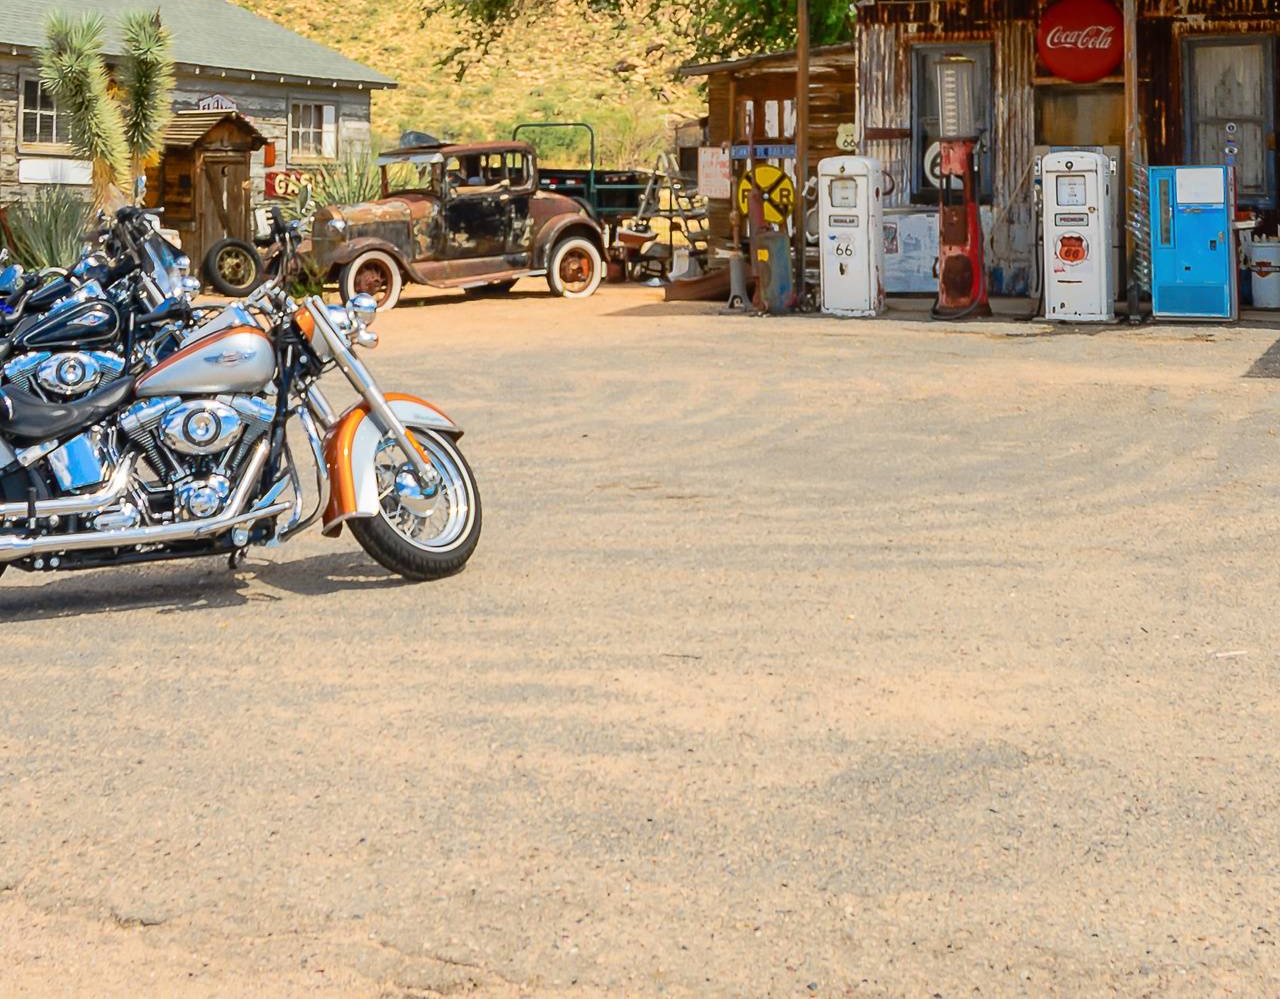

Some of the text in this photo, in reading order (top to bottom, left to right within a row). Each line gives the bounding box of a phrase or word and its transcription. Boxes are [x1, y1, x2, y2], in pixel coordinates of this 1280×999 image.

[1046, 25, 1116, 49] Coca-Cola
[843, 139, 857, 148] 66
[835, 243, 853, 256] 66
[1064, 248, 1080, 258] 66
